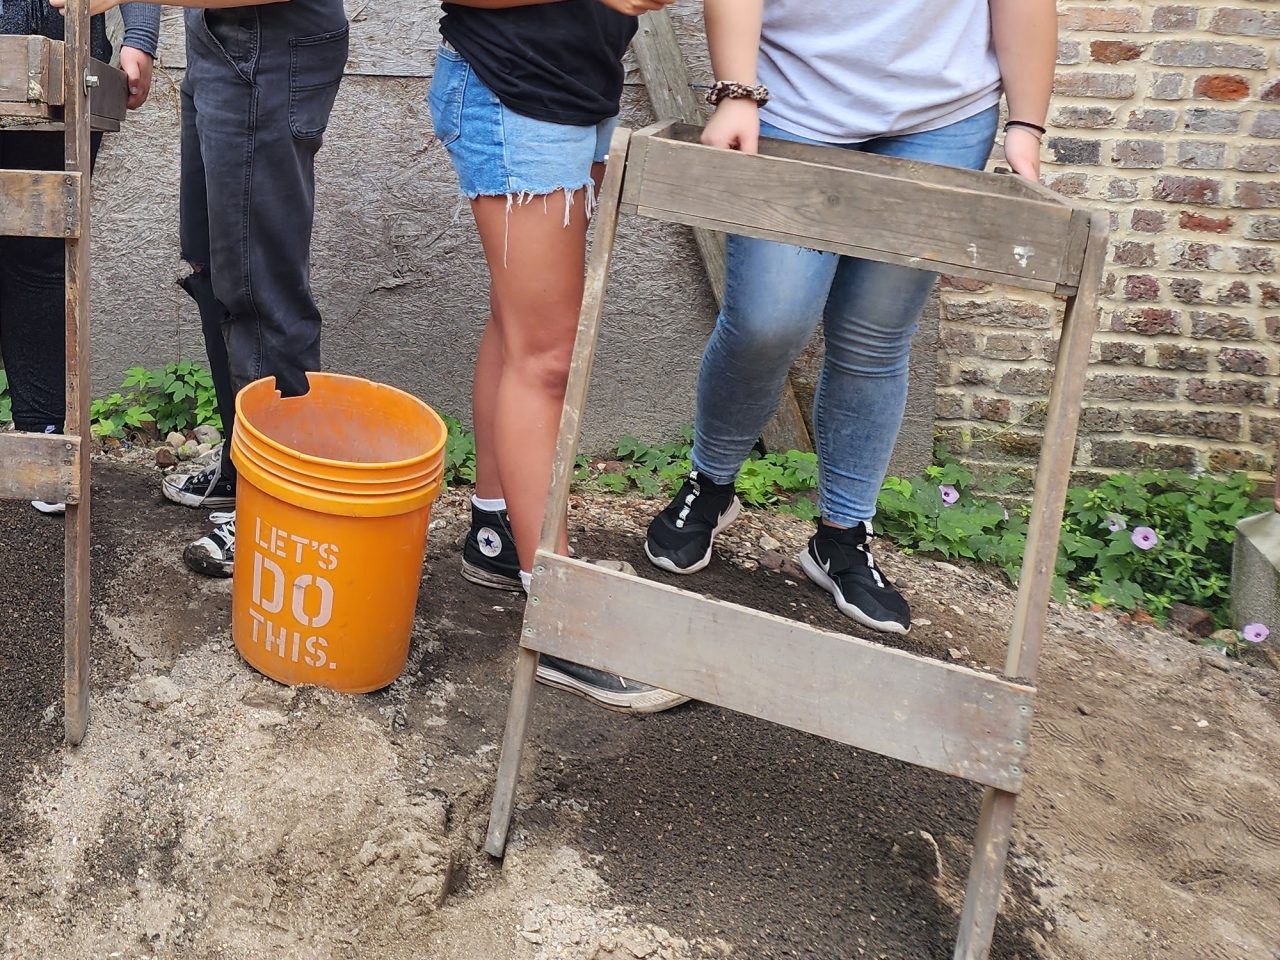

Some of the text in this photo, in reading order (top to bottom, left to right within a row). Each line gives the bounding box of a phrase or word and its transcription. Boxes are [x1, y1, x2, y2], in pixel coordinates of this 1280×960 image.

[255, 517, 339, 570] LET'S
[252, 550, 334, 628] DO
[249, 608, 337, 669] THIS.
